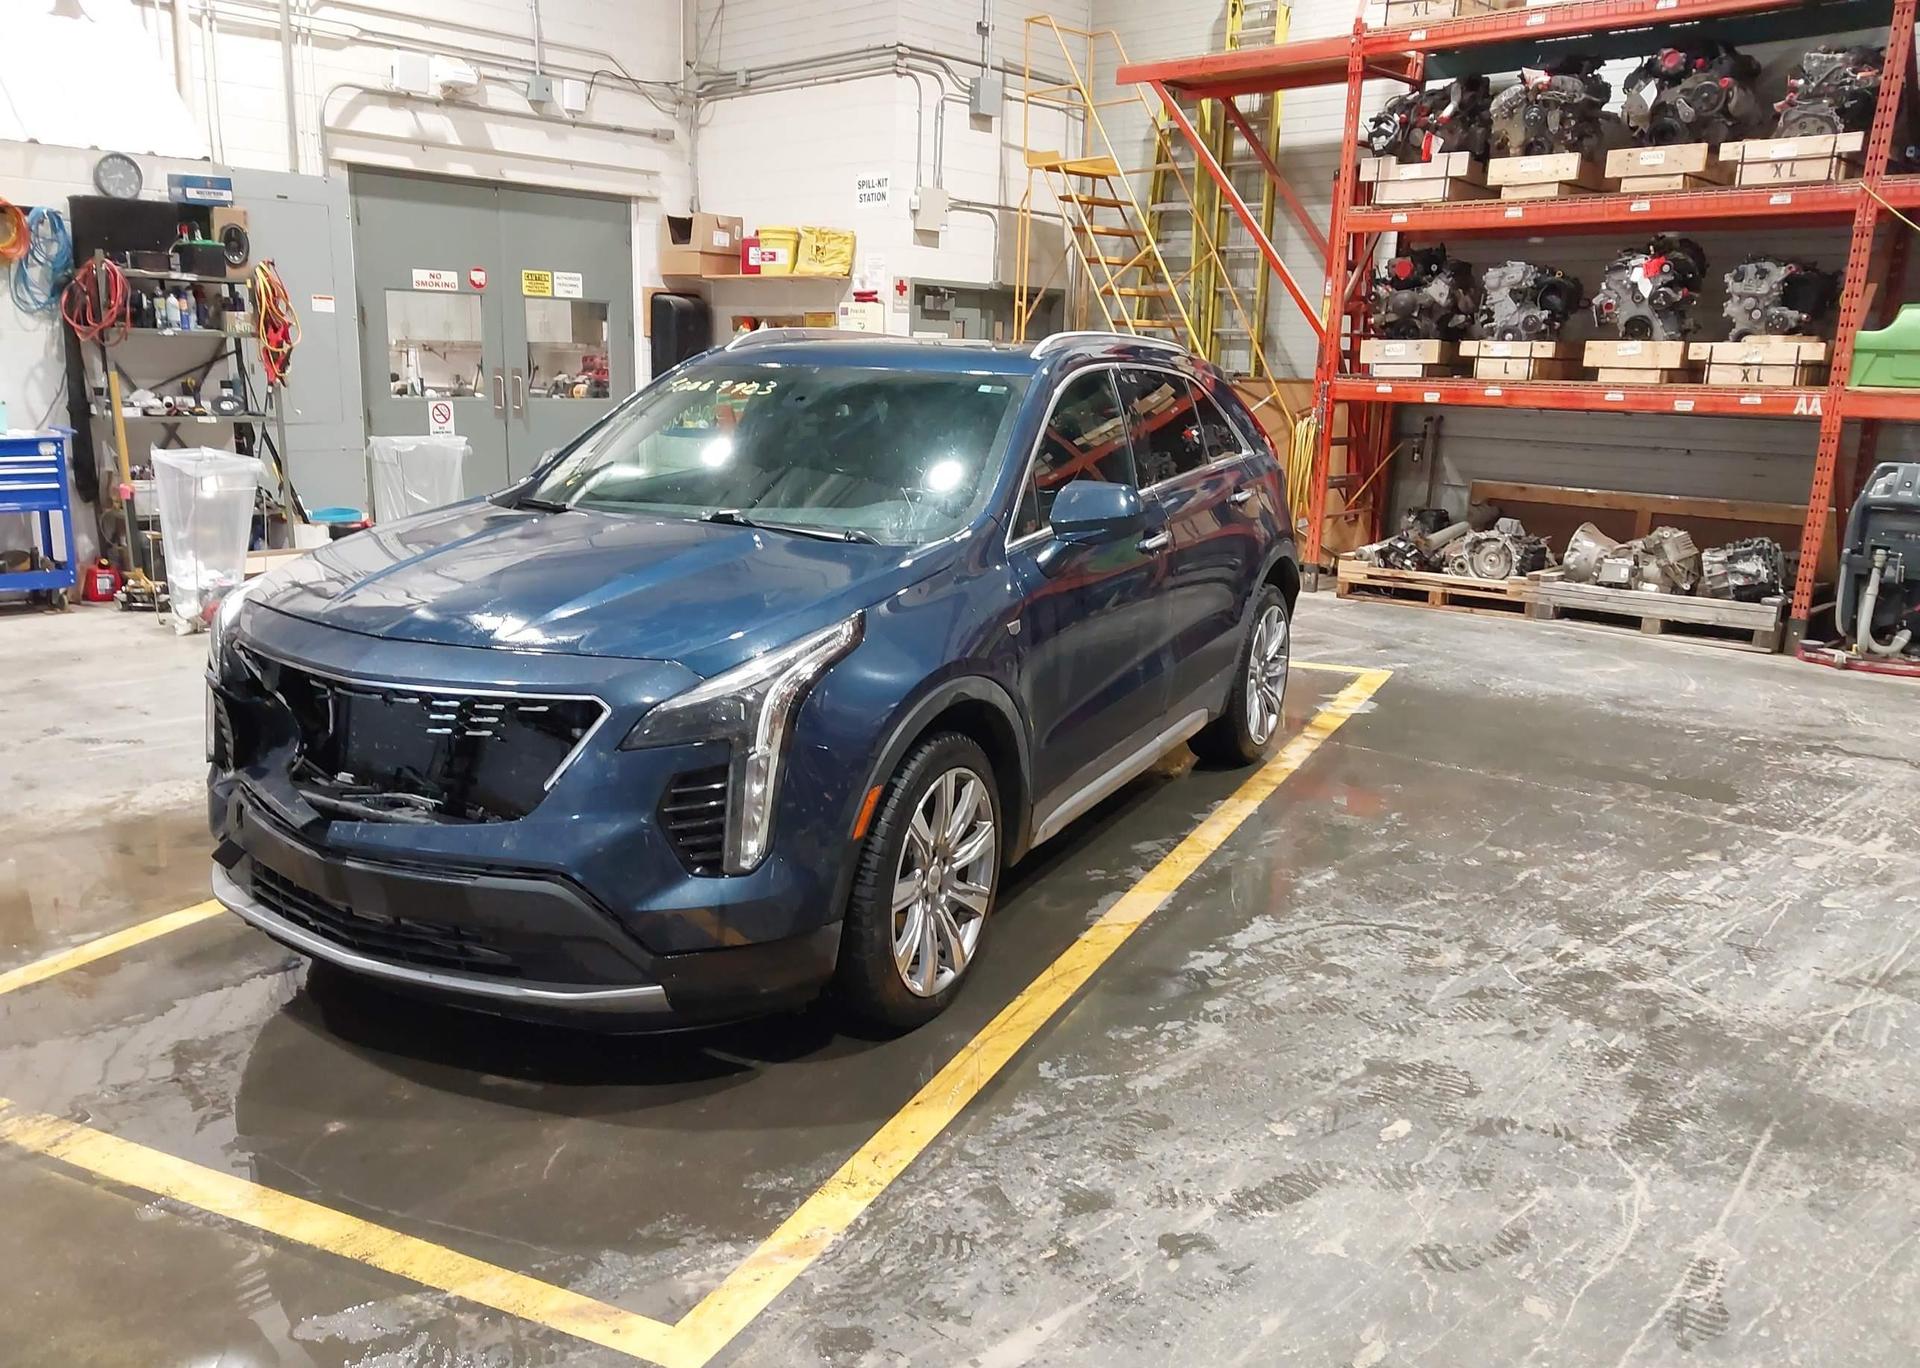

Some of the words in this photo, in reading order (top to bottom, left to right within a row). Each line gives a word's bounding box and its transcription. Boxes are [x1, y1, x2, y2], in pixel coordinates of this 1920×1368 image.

[857, 177, 889, 190] SPILL-KIT
[858, 191, 887, 203] STATION
[428, 272, 442, 280] NO
[524, 272, 550, 282] CAUTION
[415, 279, 457, 289] SMOKING
[1503, 361, 1510, 375] L
[1793, 396, 1823, 415] AA
